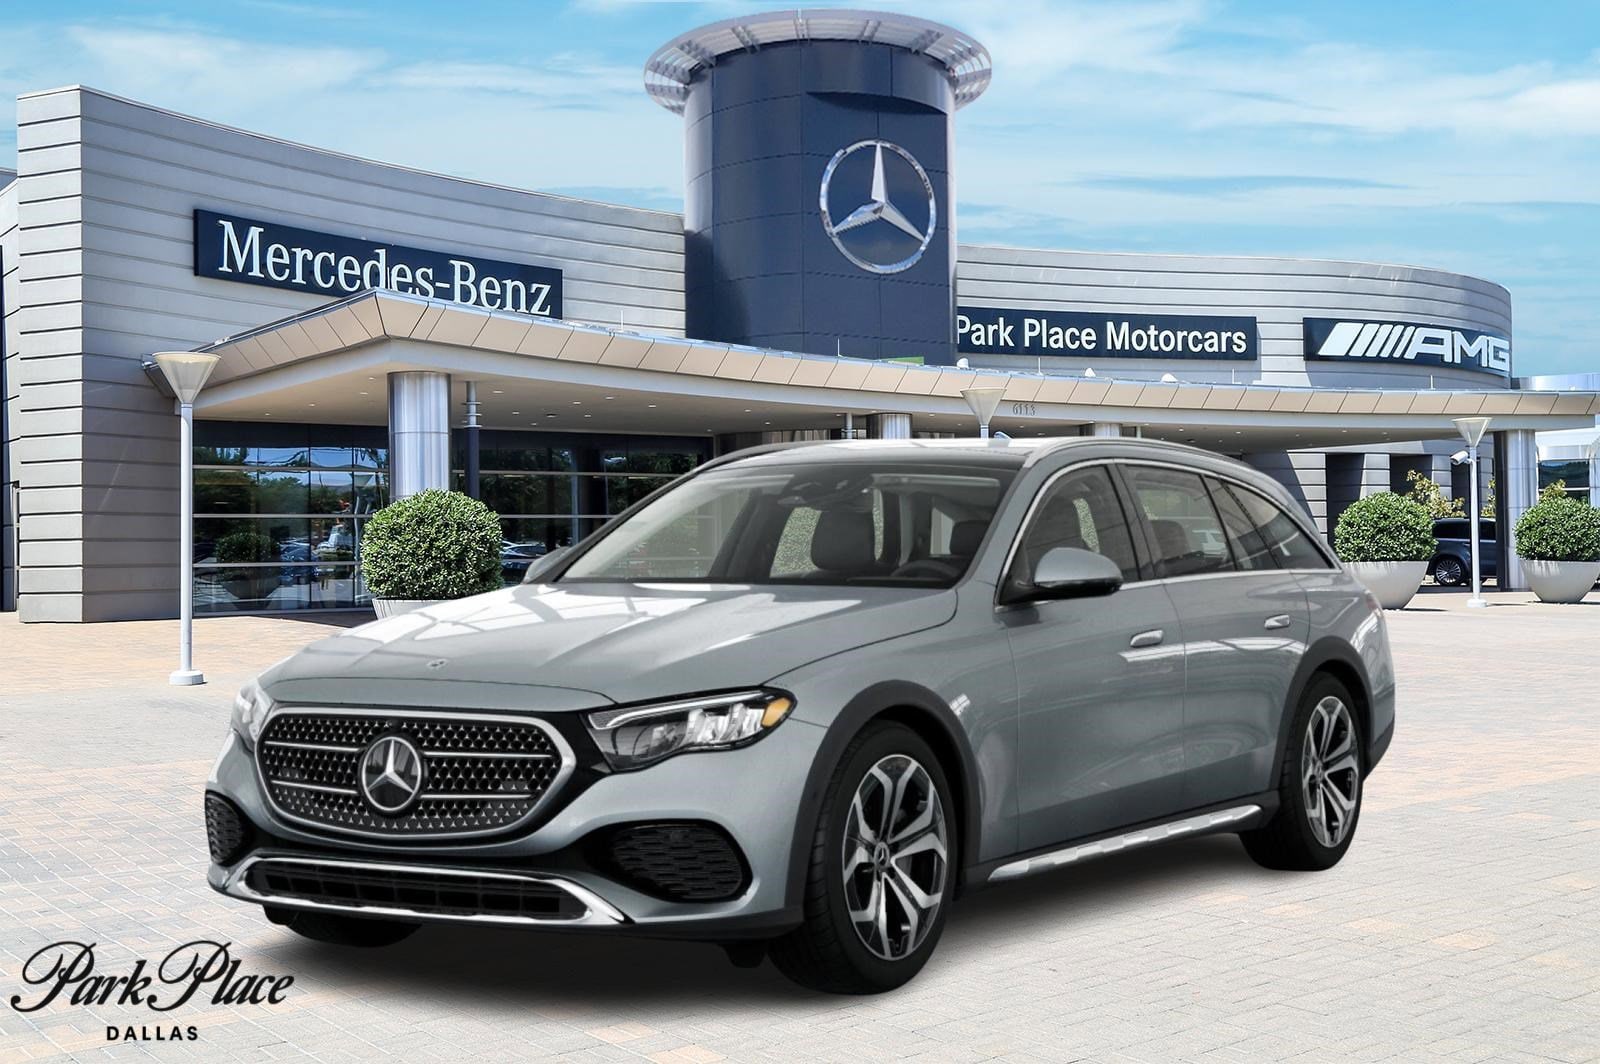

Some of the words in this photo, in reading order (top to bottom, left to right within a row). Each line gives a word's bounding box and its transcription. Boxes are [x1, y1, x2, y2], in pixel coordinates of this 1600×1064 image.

[217, 219, 552, 316] Mercedes-Benz
[956, 315, 1014, 346] Park
[1024, 318, 1097, 349] Place
[1106, 321, 1247, 353] Motorcars
[1403, 327, 1510, 372] AMG
